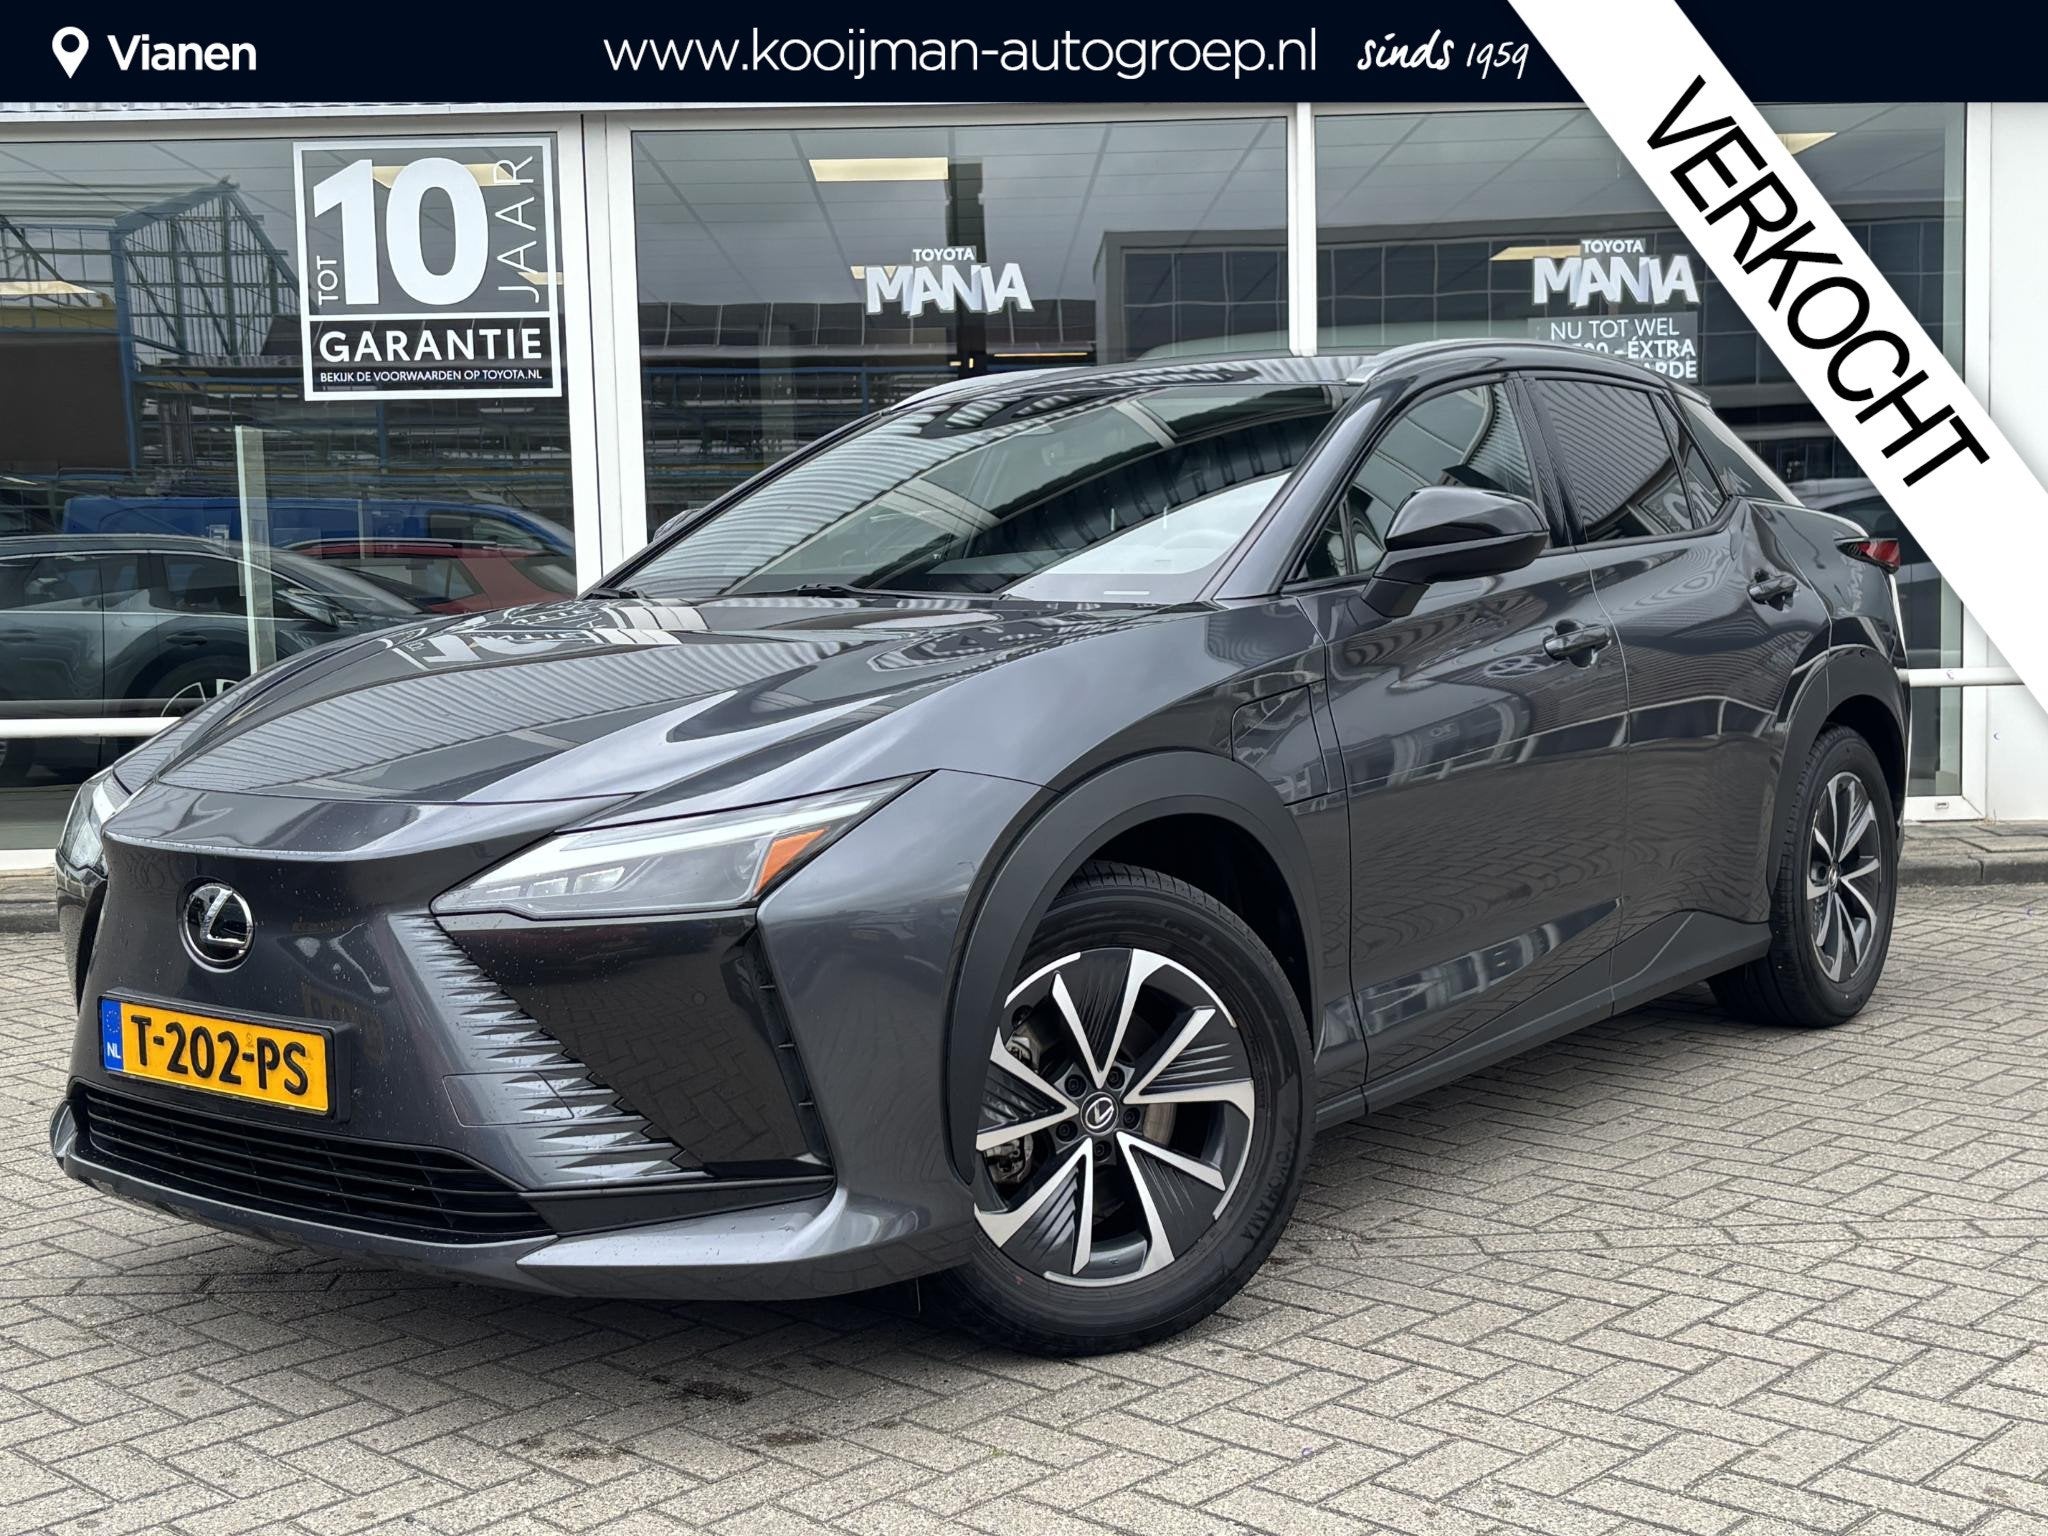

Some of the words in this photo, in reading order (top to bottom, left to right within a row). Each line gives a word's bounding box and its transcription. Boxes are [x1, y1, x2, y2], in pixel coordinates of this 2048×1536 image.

[313, 157, 489, 305] 10
[493, 155, 540, 303] JAAR
[1582, 239, 1645, 254] TOYOTA
[912, 247, 976, 262] TOYOTA
[316, 255, 339, 305] TOT
[865, 262, 1035, 317] MANIA
[1533, 255, 1699, 308] MANIA
[319, 328, 542, 363] GARANTIE
[1551, 321, 1582, 341] NU
[1588, 319, 1629, 339] TOT
[1634, 317, 1680, 337] WEL
[320, 372, 354, 382] BEKIJK
[356, 371, 372, 382] DE
[373, 369, 462, 382] VOORWAARDEN
[463, 370, 481, 379] OP
[483, 369, 543, 380] TOYOTA.NL
[106, 1042, 121, 1059] NL
[131, 1014, 308, 1096] T-202-PS
